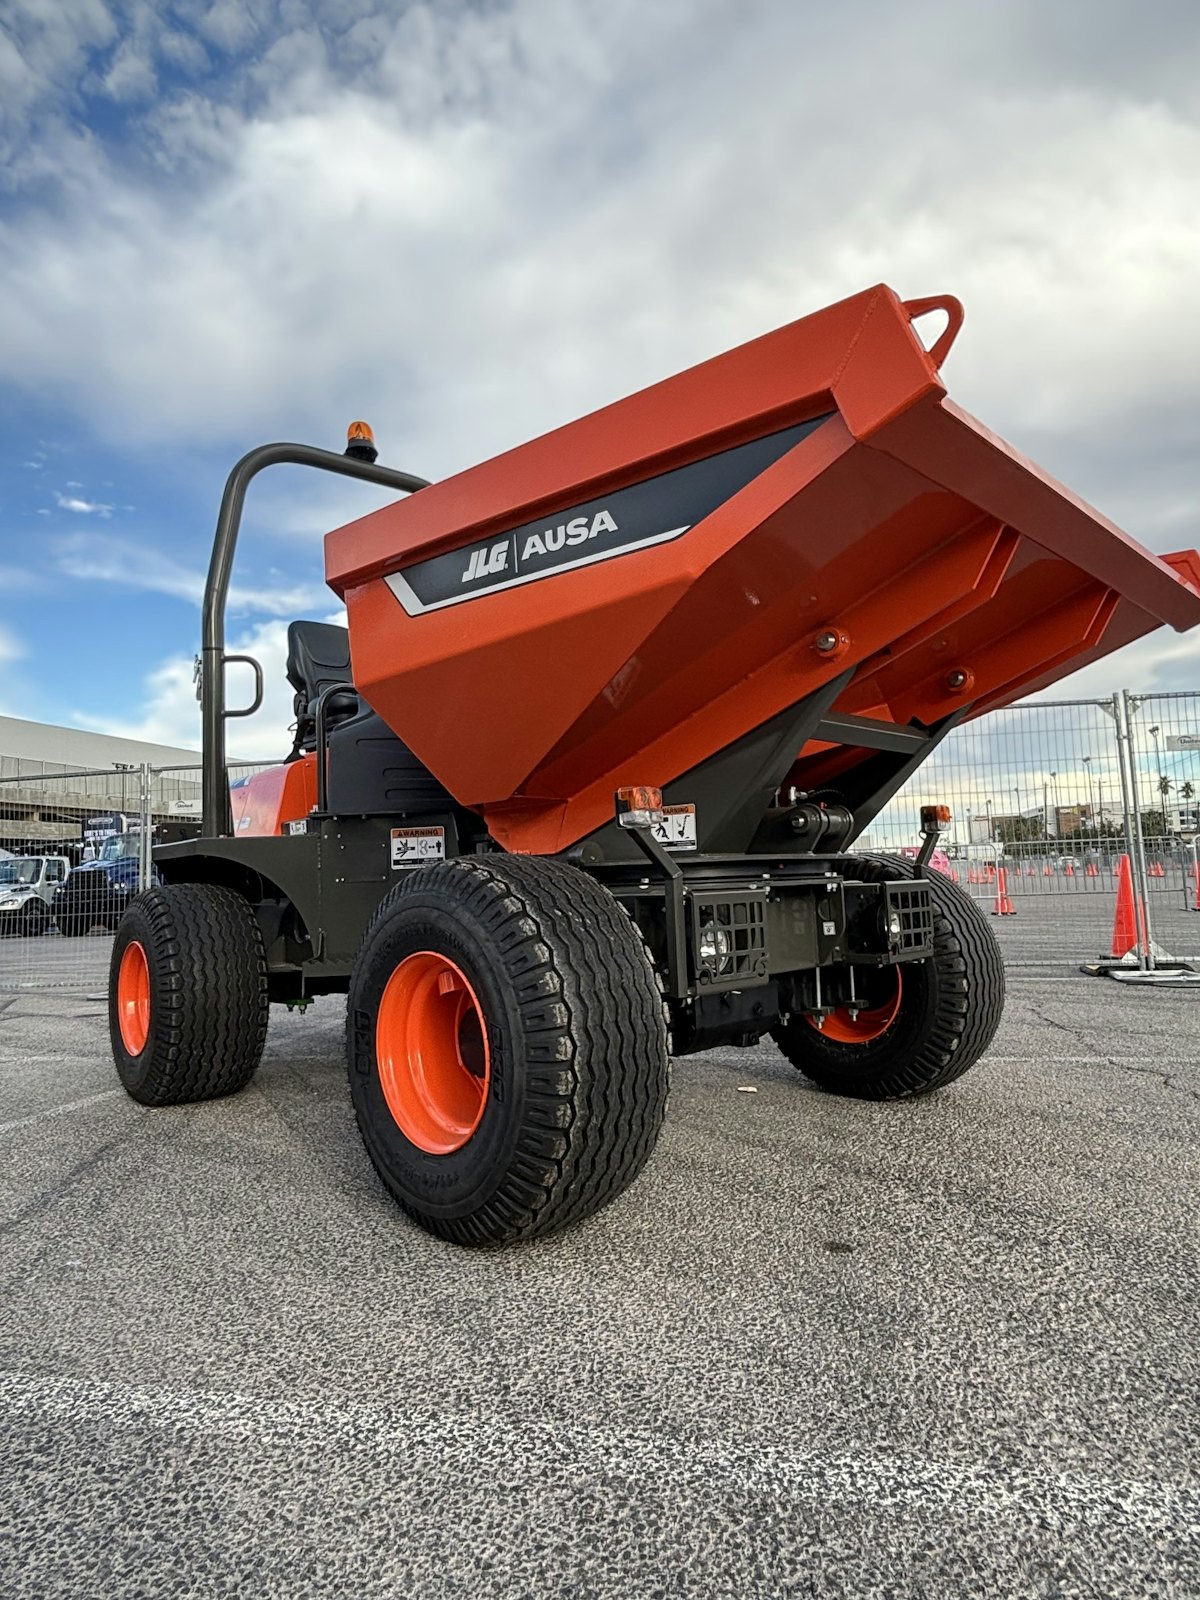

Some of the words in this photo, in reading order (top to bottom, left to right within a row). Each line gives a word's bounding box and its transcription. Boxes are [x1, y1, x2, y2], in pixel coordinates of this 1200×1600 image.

[461, 541, 509, 583] JLG
[521, 510, 619, 560] AUSA
[402, 829, 439, 837] WARNING
